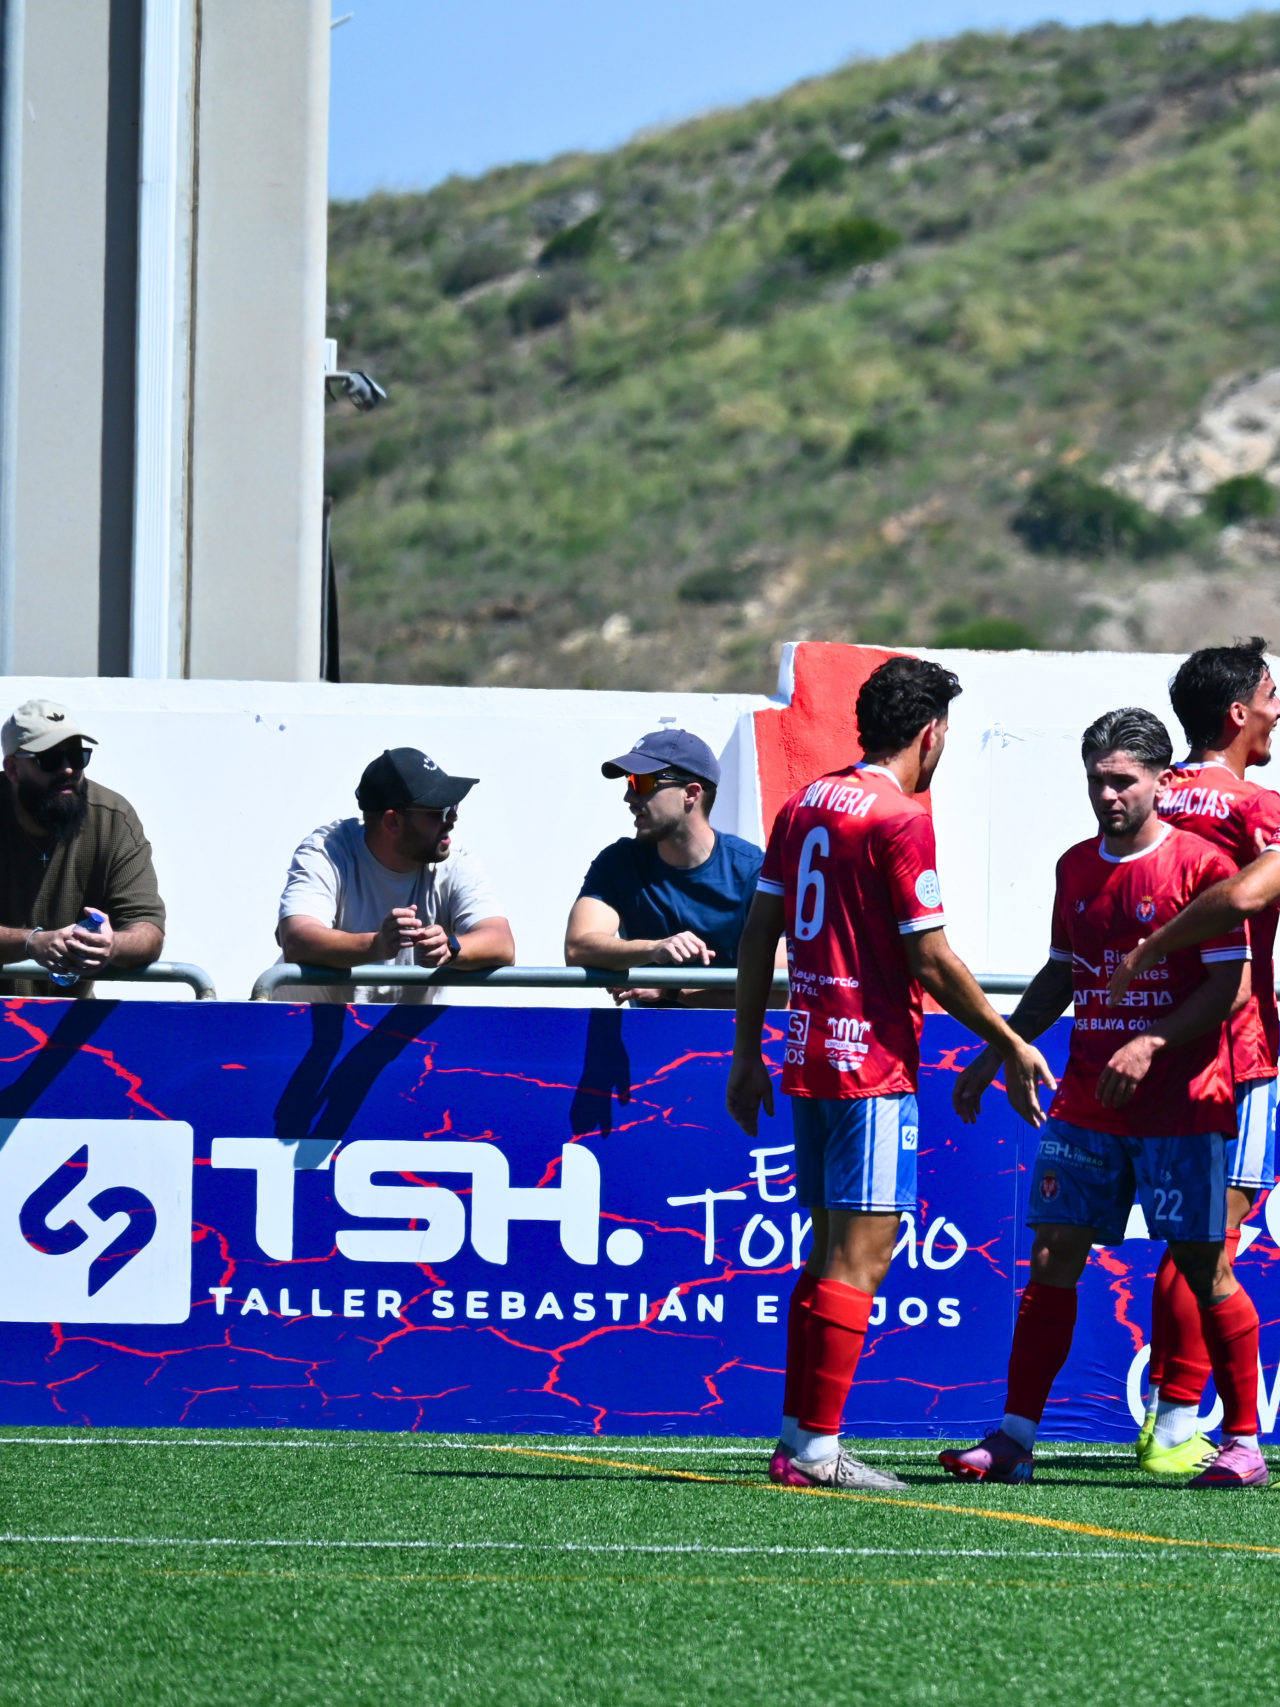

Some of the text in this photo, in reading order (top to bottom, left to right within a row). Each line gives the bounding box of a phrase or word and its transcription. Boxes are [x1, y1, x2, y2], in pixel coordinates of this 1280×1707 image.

[827, 785, 878, 818] VERA
[1157, 787, 1235, 819] MACIAS
[795, 825, 830, 942] 6
[792, 966, 859, 988] laya garcía
[1105, 965, 1169, 980] Fntes
[791, 981, 819, 997] 017S.L
[1090, 1018, 1125, 1031] BLAYA
[1128, 1015, 1157, 1031] GÓM
[211, 1137, 644, 1265] TSH.
[1153, 1188, 1183, 1222] 22
[208, 1286, 962, 1327] TALLER SEBASTIÁN E JOS
